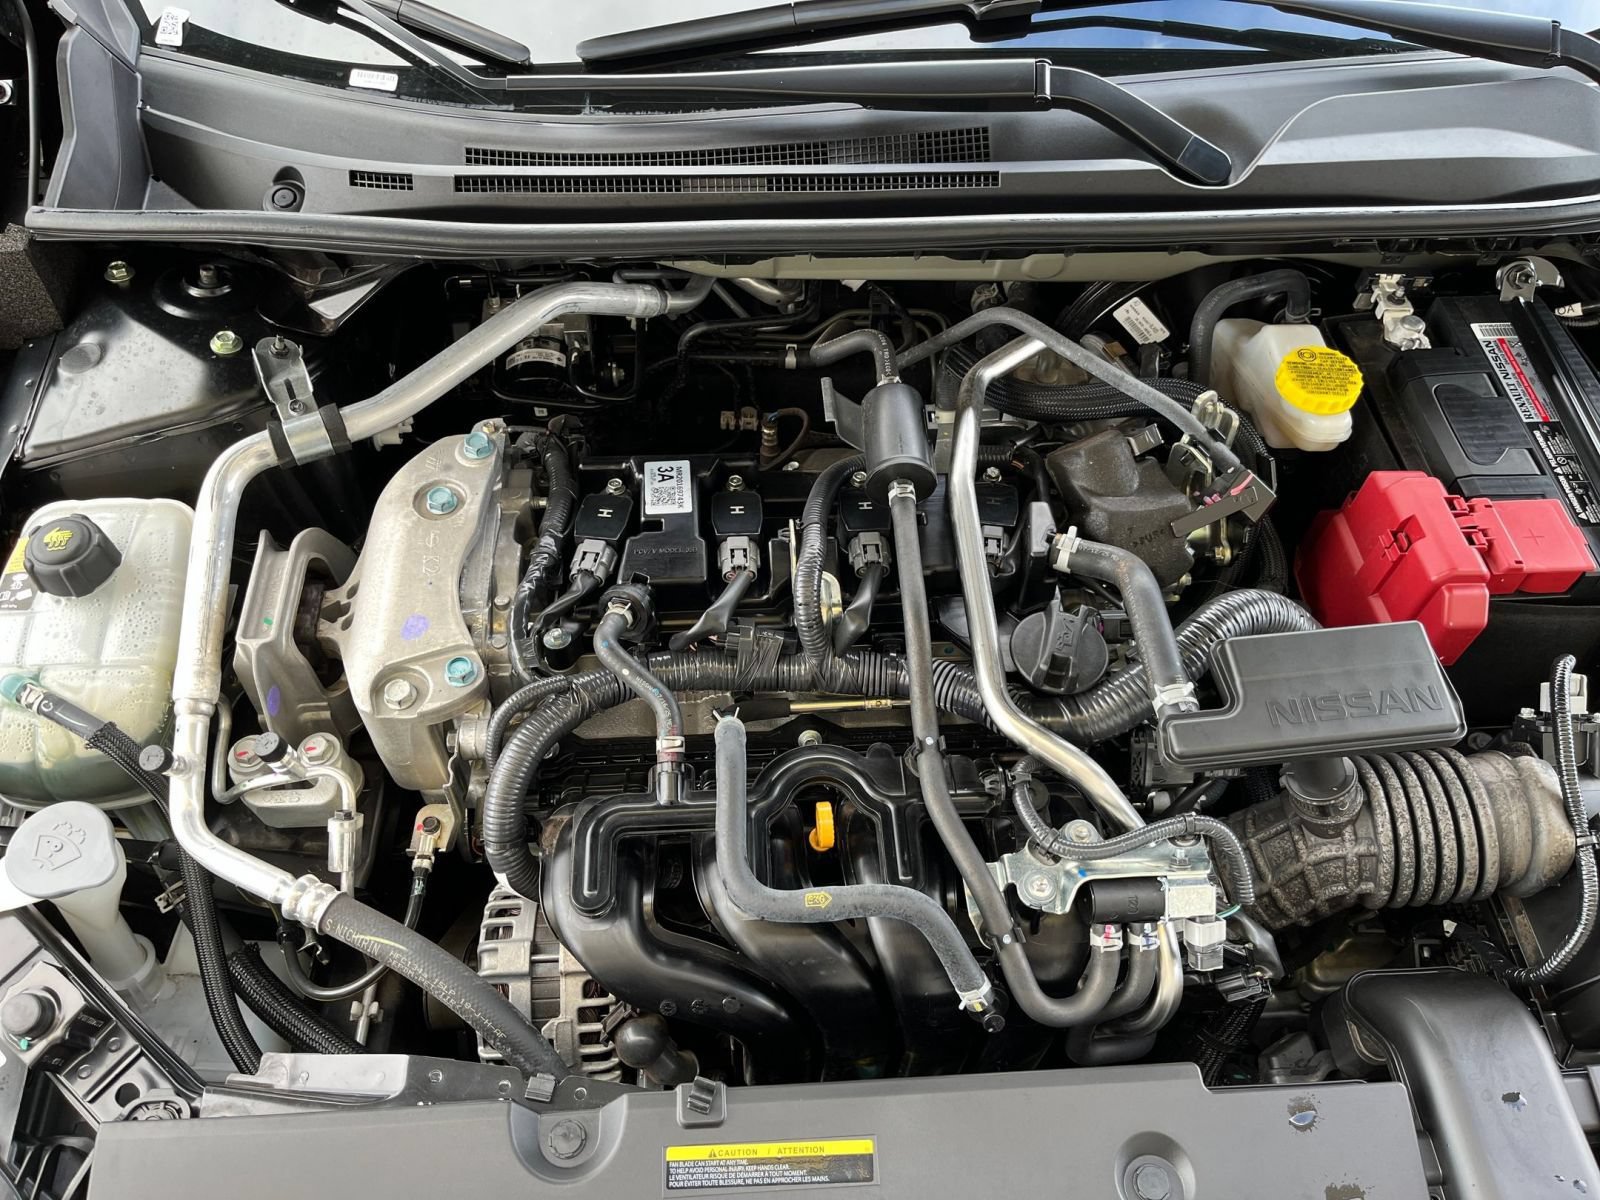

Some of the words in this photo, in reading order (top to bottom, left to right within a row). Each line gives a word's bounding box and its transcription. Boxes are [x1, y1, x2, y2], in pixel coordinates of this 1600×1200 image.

[1483, 340, 1512, 380] NISSAN
[1506, 380, 1535, 420] RENAULT
[657, 466, 675, 483] 3A
[1265, 685, 1444, 728] NISSAN
[717, 1148, 758, 1158] CAUTION
[777, 1146, 825, 1155] ATTENTION
